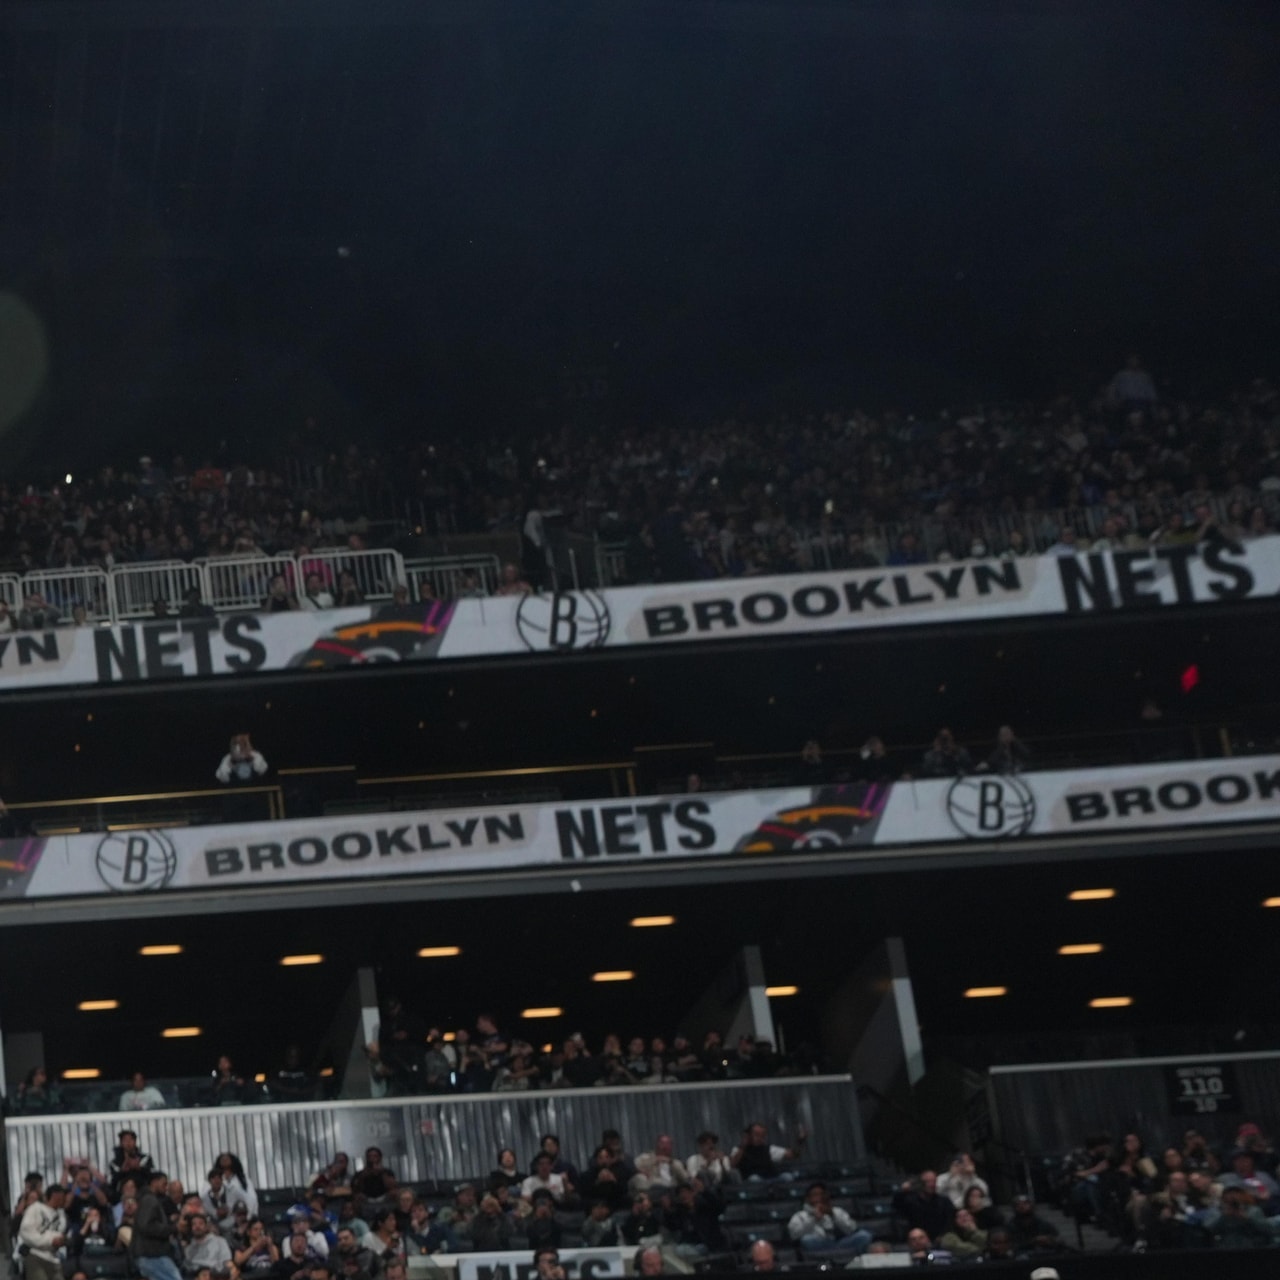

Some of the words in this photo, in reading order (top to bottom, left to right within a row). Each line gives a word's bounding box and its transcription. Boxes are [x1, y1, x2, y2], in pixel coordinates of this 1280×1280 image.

[642, 562, 1022, 638] BROOKLYN
[1058, 541, 1256, 612] NETS
[95, 615, 268, 684] NETS
[206, 813, 525, 877] BROOKLYN
[553, 801, 718, 858] NETS
[1180, 1078, 1225, 1098] 110
